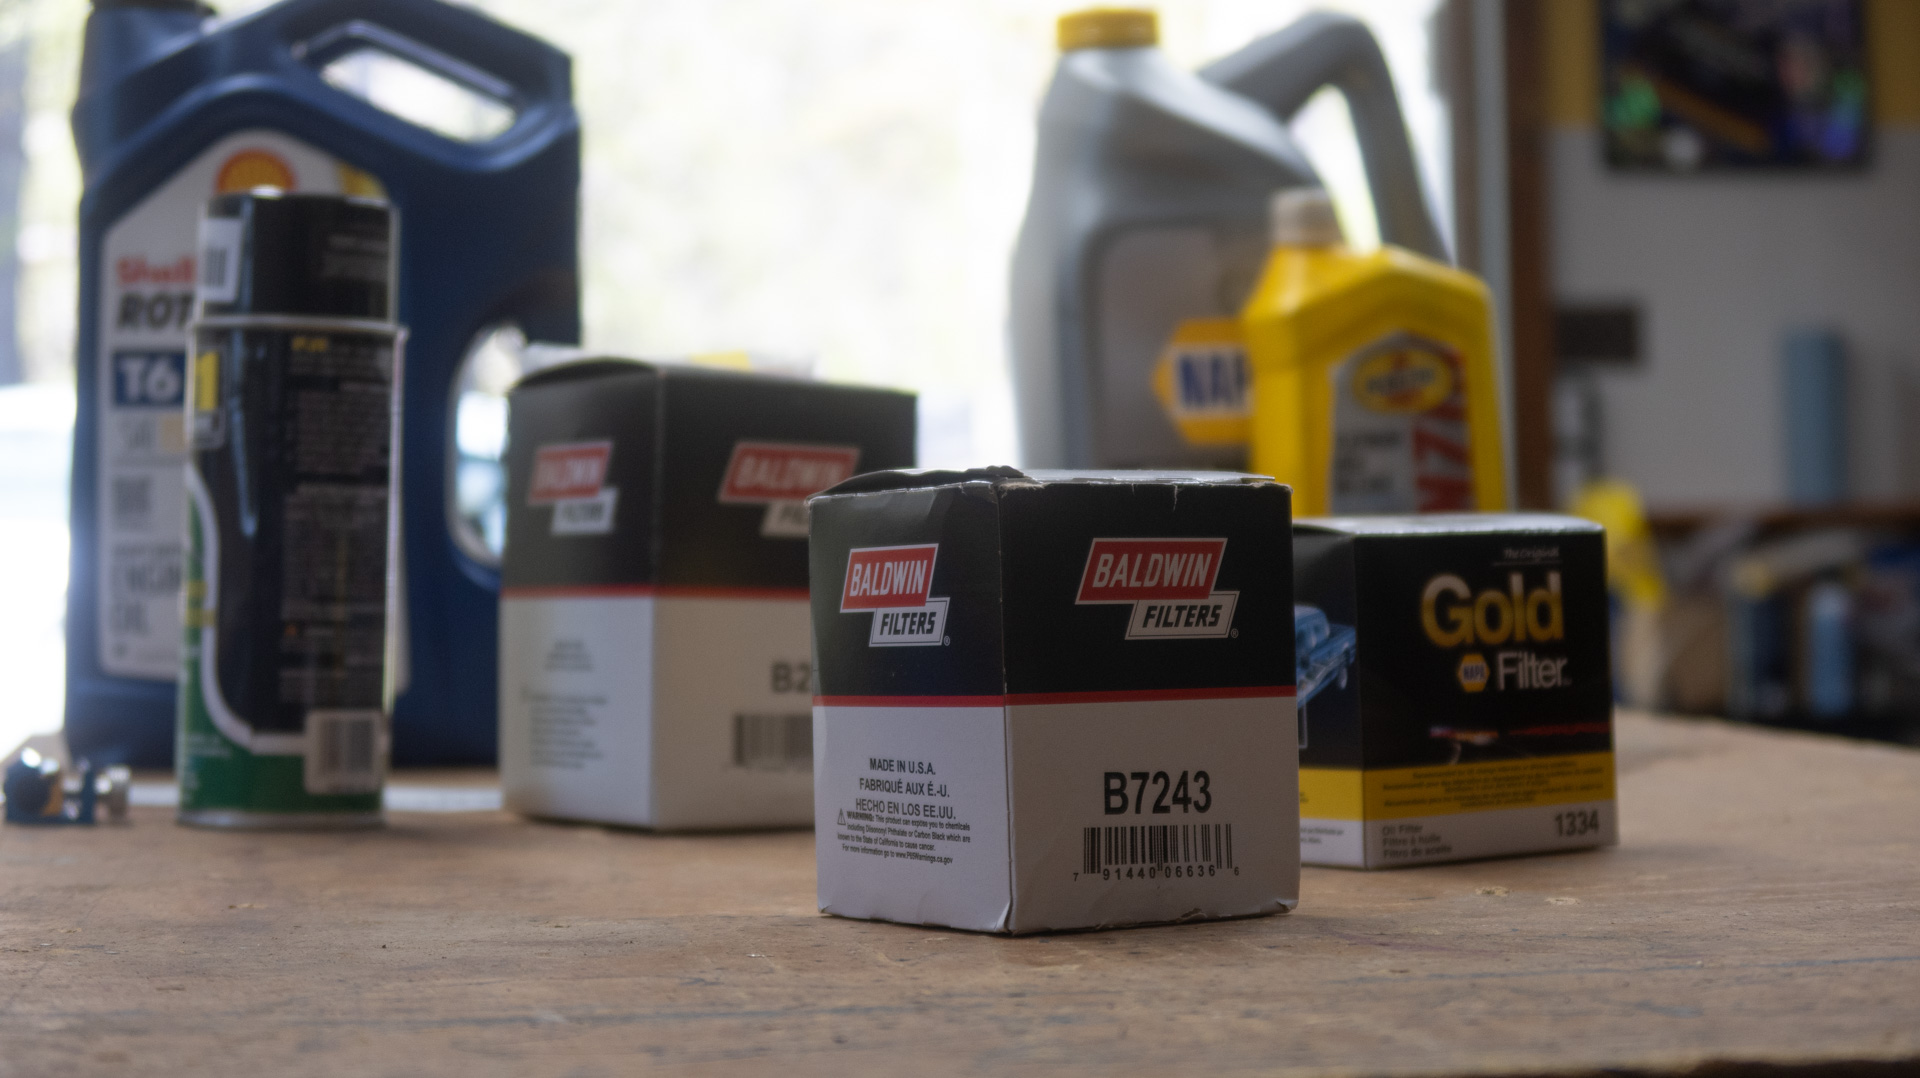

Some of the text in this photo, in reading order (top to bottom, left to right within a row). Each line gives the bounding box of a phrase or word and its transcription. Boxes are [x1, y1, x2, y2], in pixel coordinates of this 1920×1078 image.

[121, 357, 181, 401] T6
[849, 559, 927, 597] BALDWIN
[1092, 553, 1212, 588] BALDWIN
[1142, 604, 1223, 628] FILTERS
[1421, 571, 1564, 648] Gold
[880, 611, 937, 636] FILTERS
[1499, 651, 1568, 690] Filter
[869, 758, 936, 775] MADE IN U.S.A.
[859, 778, 950, 798] FABRIQUÉ AUX É.-U.
[1104, 770, 1212, 815] B7243
[847, 811, 874, 822] WARNING:
[875, 814, 884, 823] This
[885, 816, 902, 826] product
[902, 818, 910, 826] can
[911, 819, 928, 829] expose
[928, 821, 938, 830] you
[945, 822, 970, 831] chemicals
[856, 798, 956, 820] HECHO EN LOS EE.UU.
[914, 829, 931, 839] Carbon
[931, 831, 946, 841] Black
[946, 833, 962, 842] which
[962, 835, 970, 843] are
[1555, 810, 1601, 839] 1334
[860, 845, 883, 856] information
[863, 835, 873, 844] State
[879, 837, 899, 848] California
[905, 841, 918, 850] cause
[1073, 872, 1079, 882] 7
[1103, 865, 1156, 881] 91440
[1164, 864, 1216, 879] 06636
